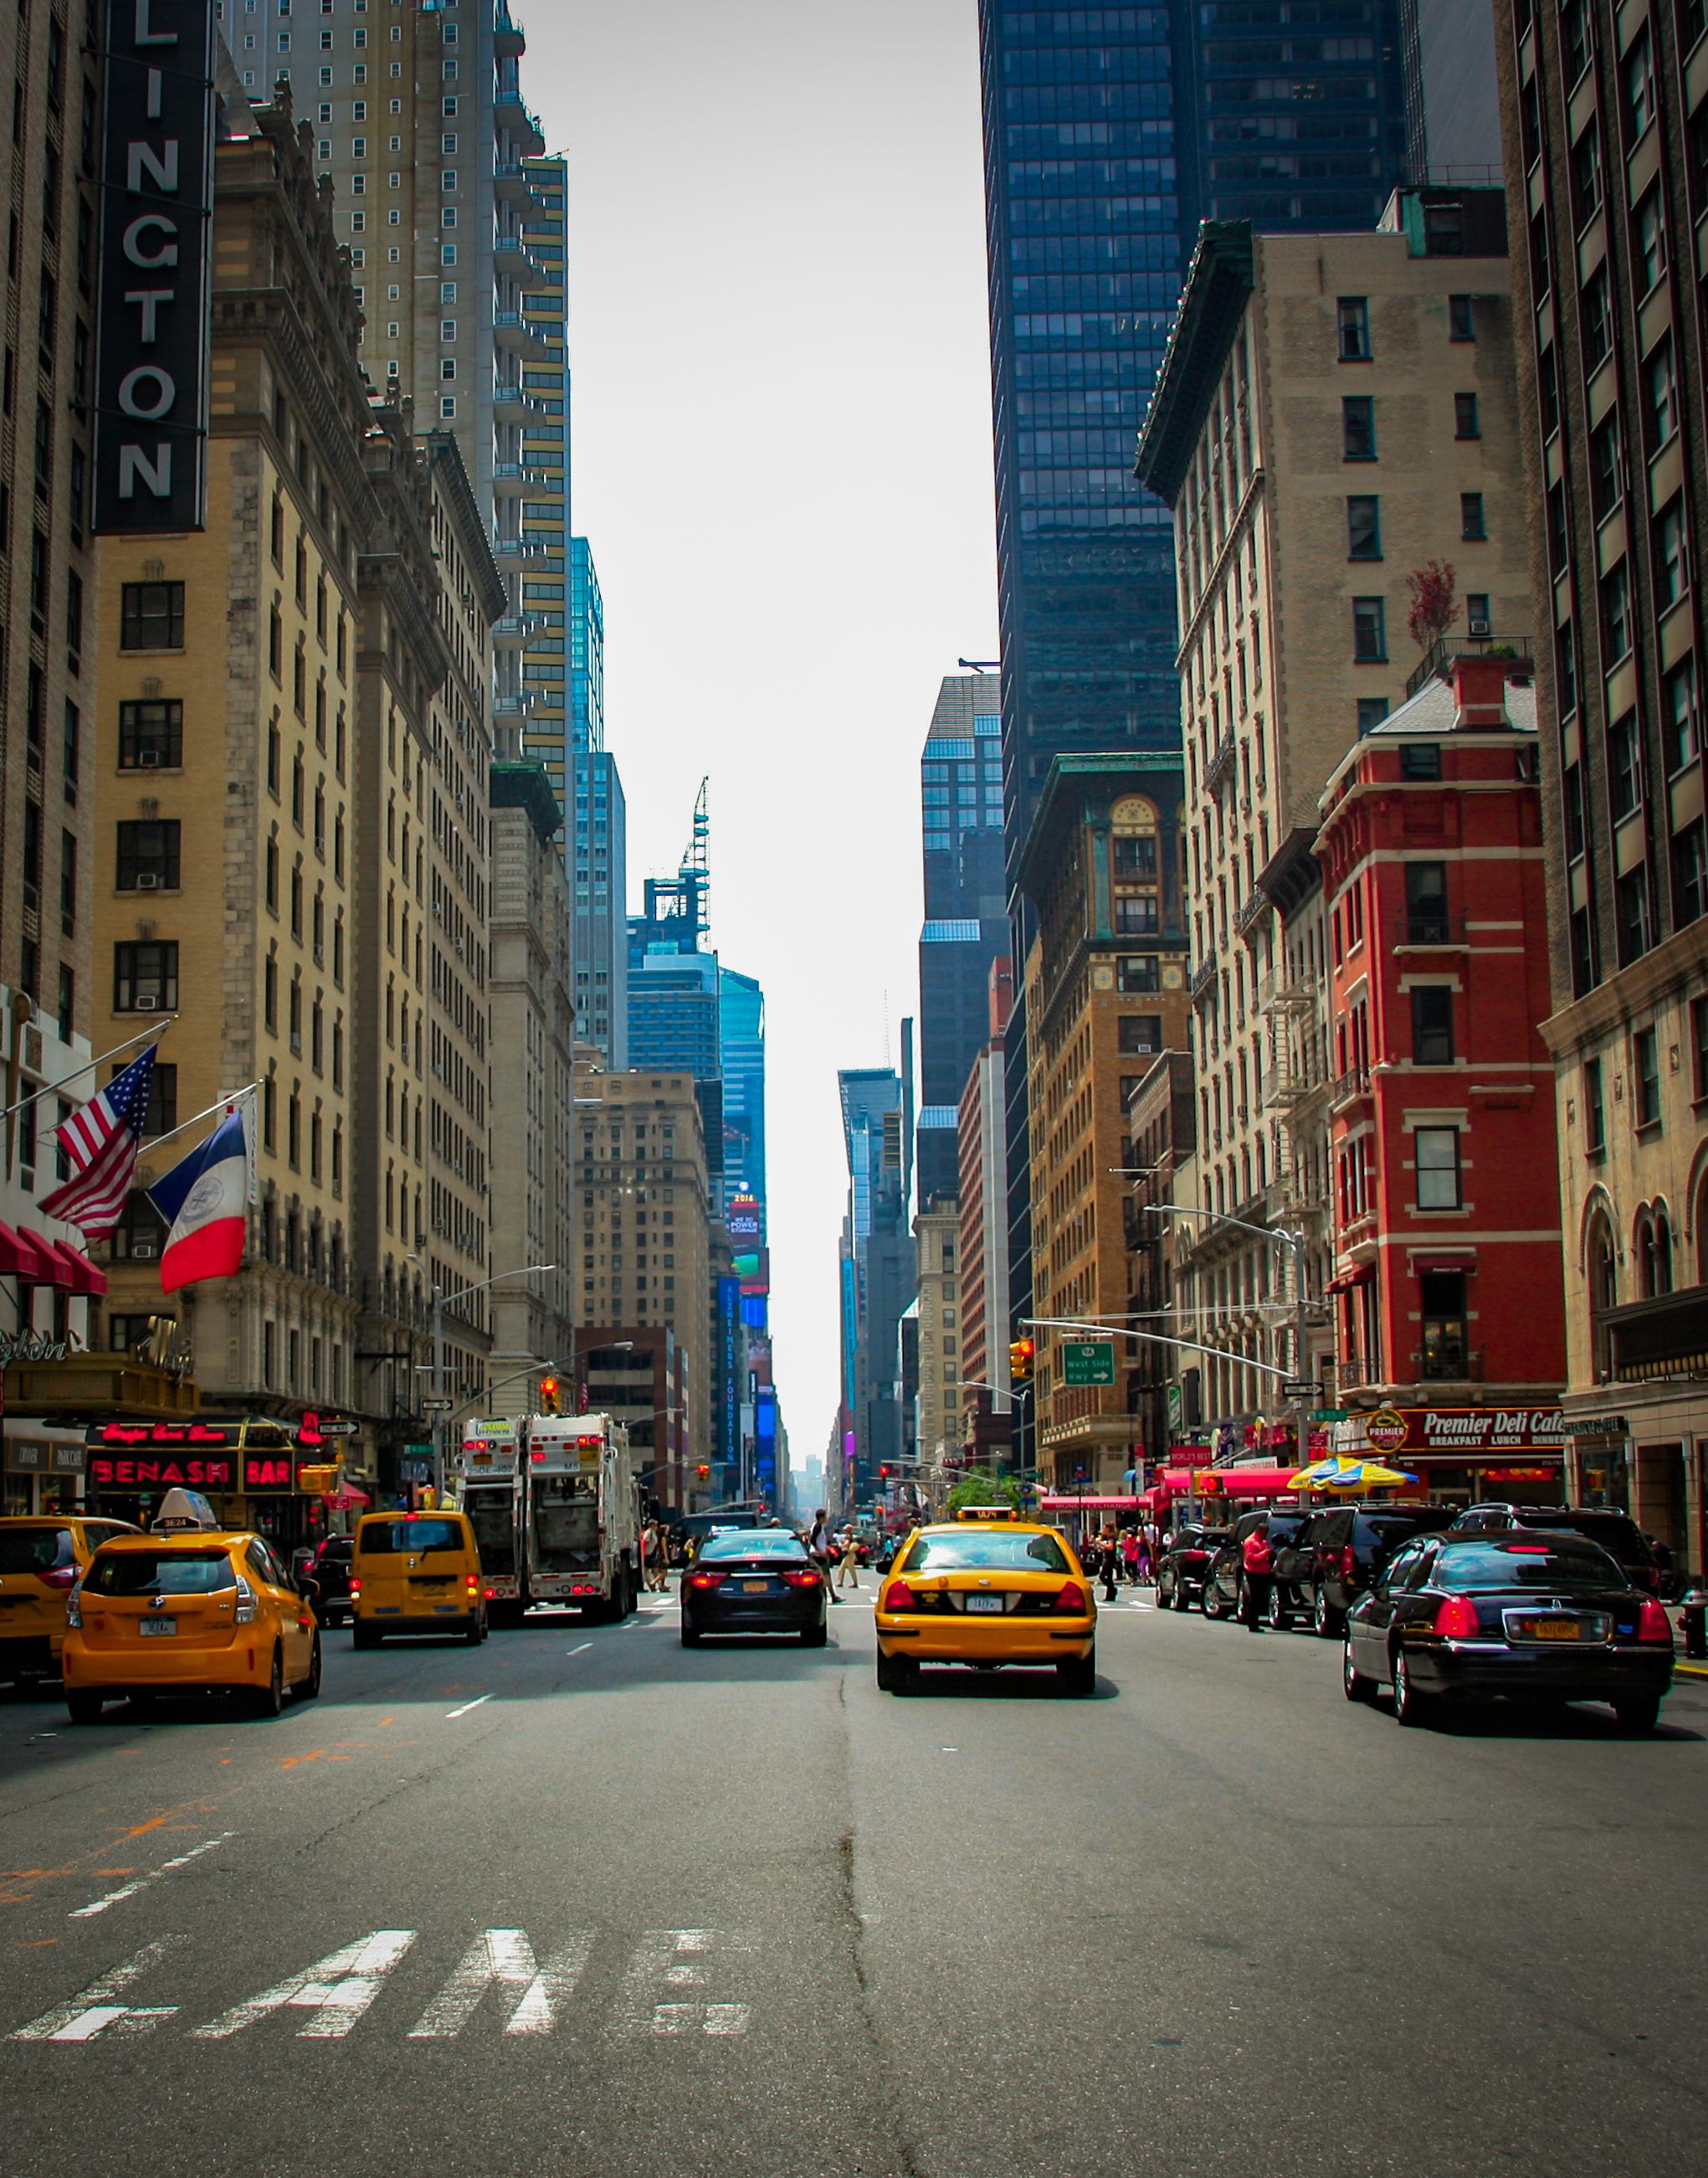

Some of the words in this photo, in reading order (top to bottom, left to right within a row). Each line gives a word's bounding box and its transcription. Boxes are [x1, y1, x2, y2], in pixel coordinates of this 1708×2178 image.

[118, 0, 177, 500] LINGTON
[1092, 1359, 1110, 1368] Side
[1069, 1373, 1088, 1382] Hwy
[1424, 1412, 1492, 1434] Premier
[1494, 1411, 1528, 1433] Deli
[1369, 1427, 1405, 1436] PREMIER
[1429, 1436, 1482, 1446] BREAKFAST
[1491, 1435, 1521, 1445] LUNCH
[1172, 1452, 1195, 1461] WORLD'S
[1197, 1451, 1211, 1460] BEST
[246, 1461, 290, 1484] BAR
[3, 1928, 751, 2041] LANE
